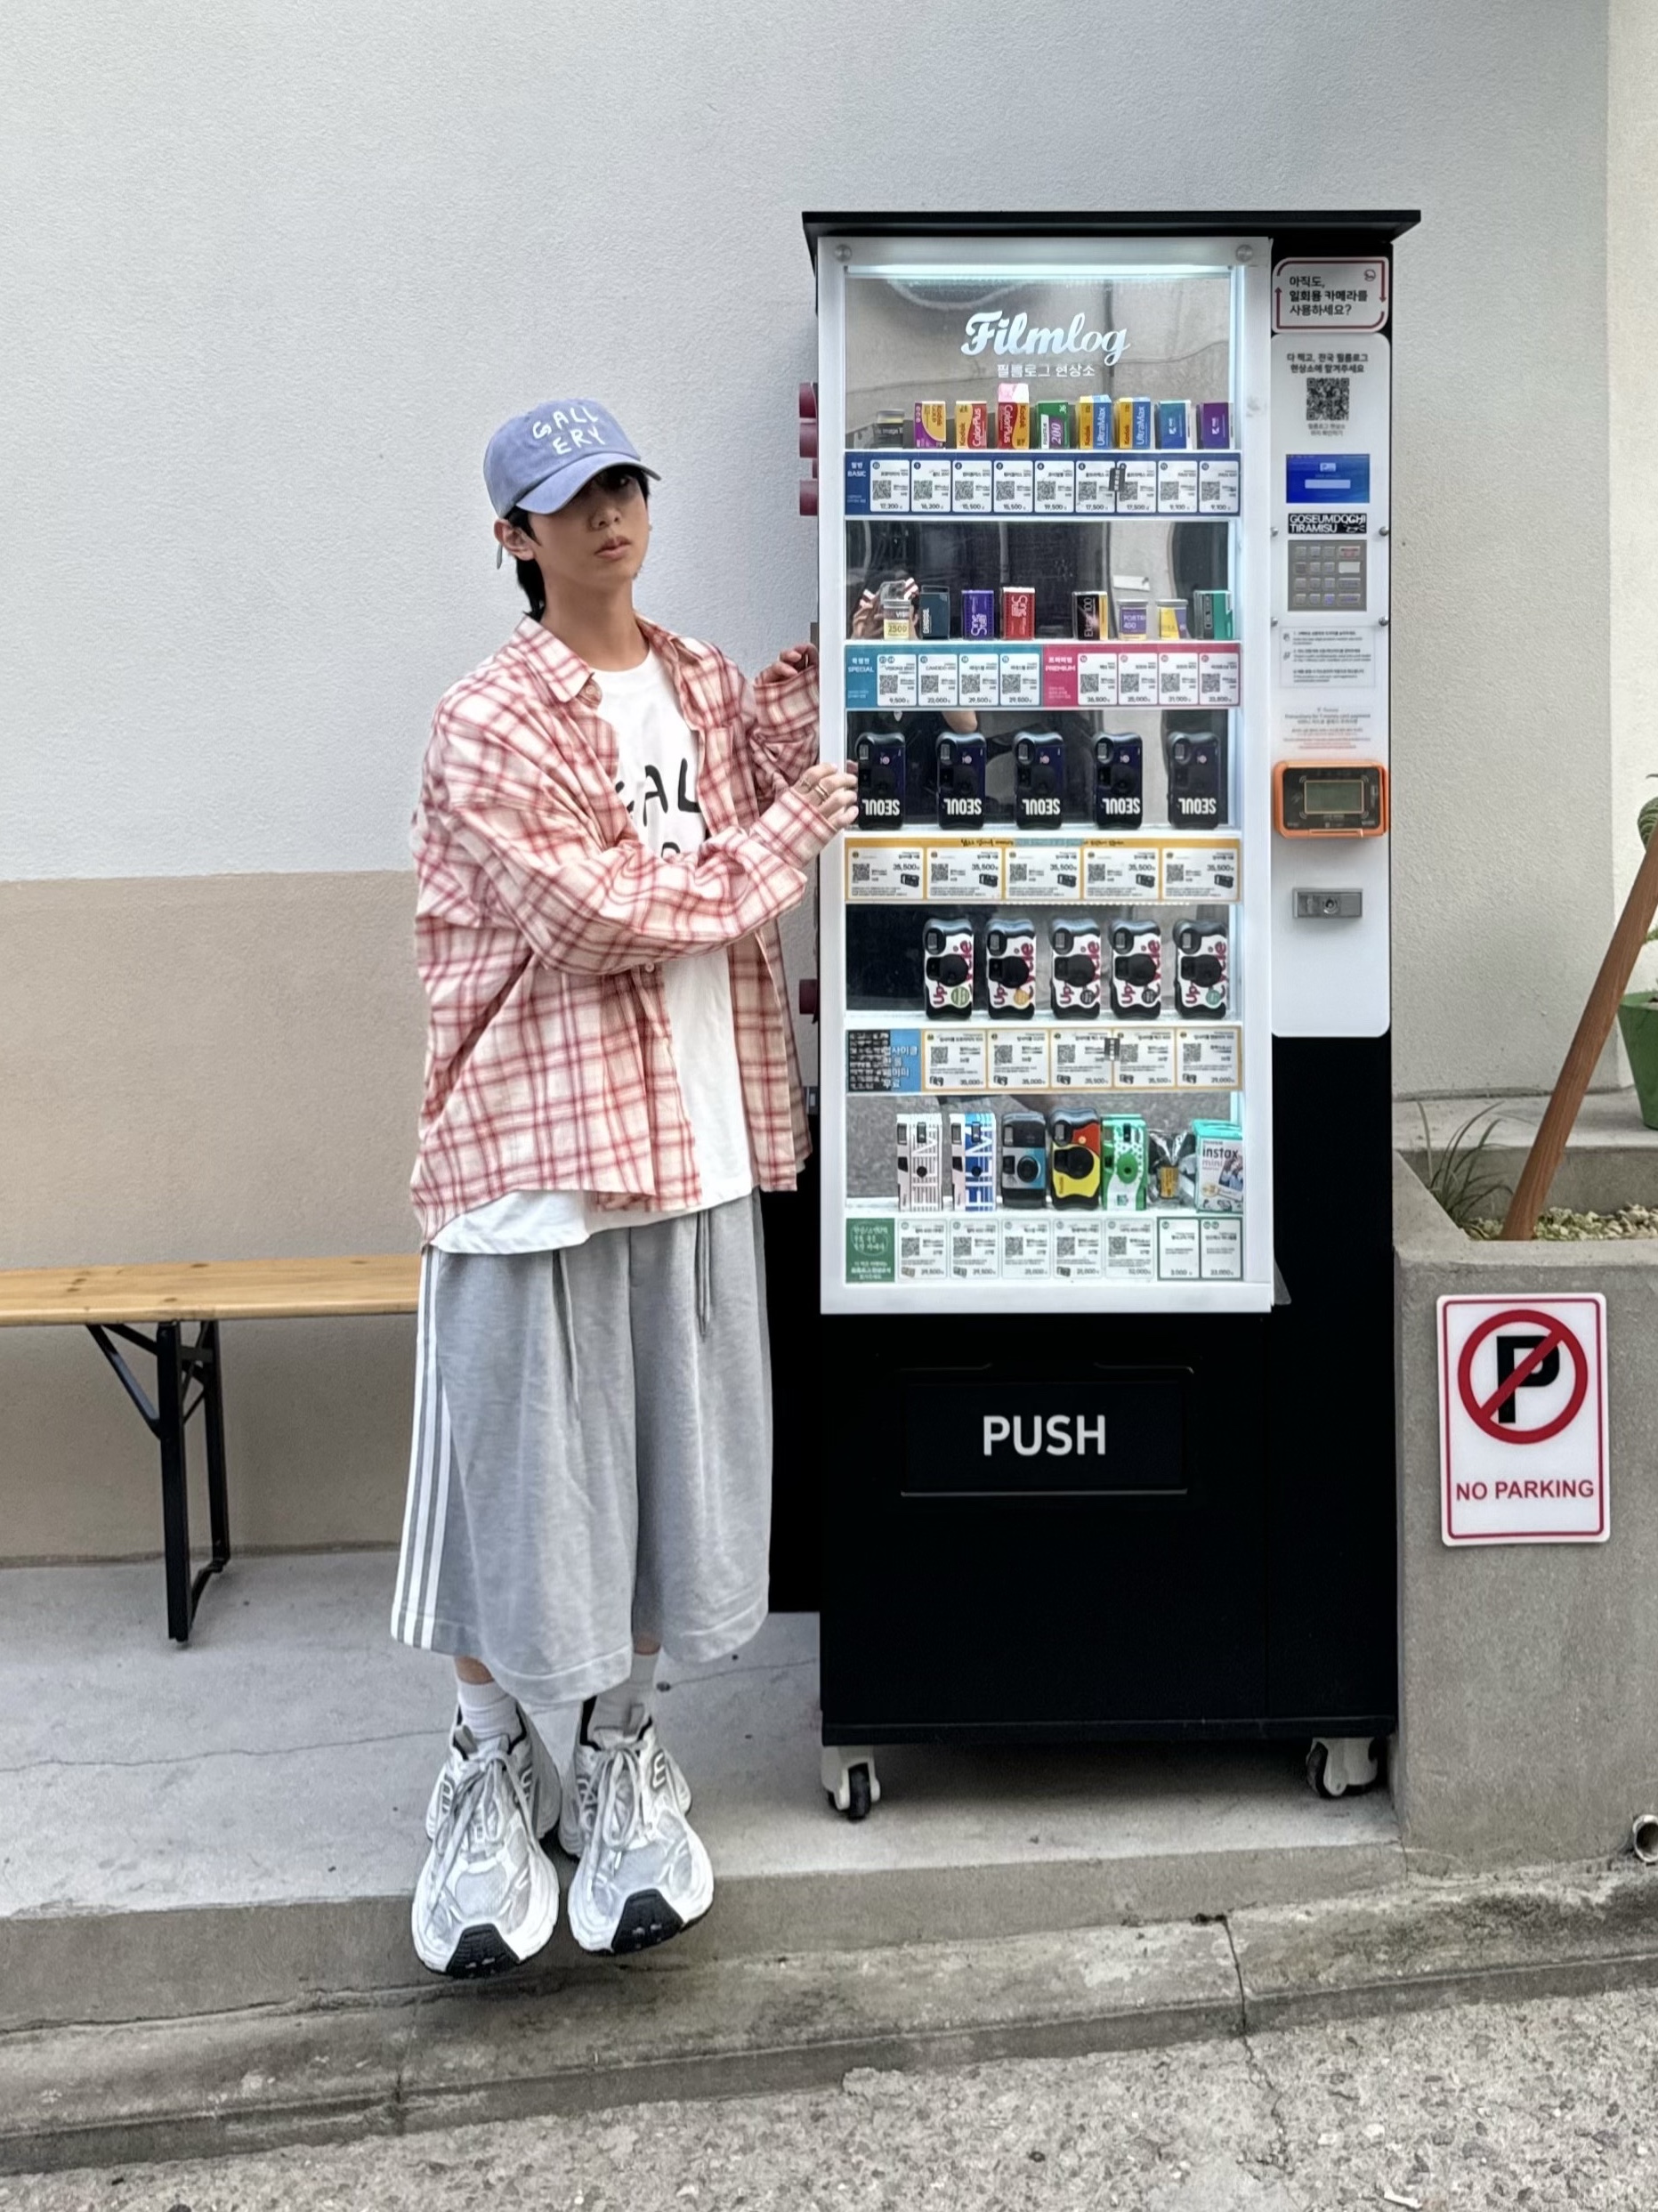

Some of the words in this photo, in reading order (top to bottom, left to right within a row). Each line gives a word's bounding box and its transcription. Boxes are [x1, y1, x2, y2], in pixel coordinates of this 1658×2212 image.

[1289, 276, 1325, 288] 아직도,
[1289, 290, 1322, 302] 일회용
[1324, 290, 1368, 302] 카메라를
[1290, 304, 1352, 316] 사용하세요?
[960, 310, 1131, 367] Filmlog
[1286, 352, 1295, 362] 다
[1336, 352, 1369, 363] 필름로그
[997, 363, 1050, 378] 필름로그
[1055, 363, 1096, 378] 현상소
[1290, 363, 1322, 373] 현상소에
[532, 406, 599, 439] GALL
[971, 408, 982, 447] ColorPlus
[1003, 404, 1014, 443] ColorPlus
[1096, 407, 1106, 447] UltraMax
[1136, 406, 1145, 446] UltraMax
[553, 425, 605, 455] ERY
[1050, 423, 1062, 445] 200
[1290, 523, 1338, 533] TIRAMISU
[1083, 597, 1092, 612] 100
[861, 798, 901, 816] SEOUL
[943, 798, 982, 815] SEOUL
[1022, 798, 1061, 815] SEOUL
[1102, 798, 1141, 814] SEOUL
[1177, 798, 1217, 814] SEOUL
[893, 863, 919, 871] 35,500
[971, 863, 999, 871] 35,500
[1049, 863, 1077, 871] 35,500
[1128, 863, 1155, 871] 35,500
[1207, 863, 1234, 871] 35,500
[1202, 1147, 1238, 1159] instax
[965, 1125, 993, 1208] FILM
[1201, 1158, 1223, 1167] mini
[983, 1414, 1106, 1456] PUSH
[1456, 1481, 1488, 1501] NO
[1495, 1479, 1594, 1500] PARKING
